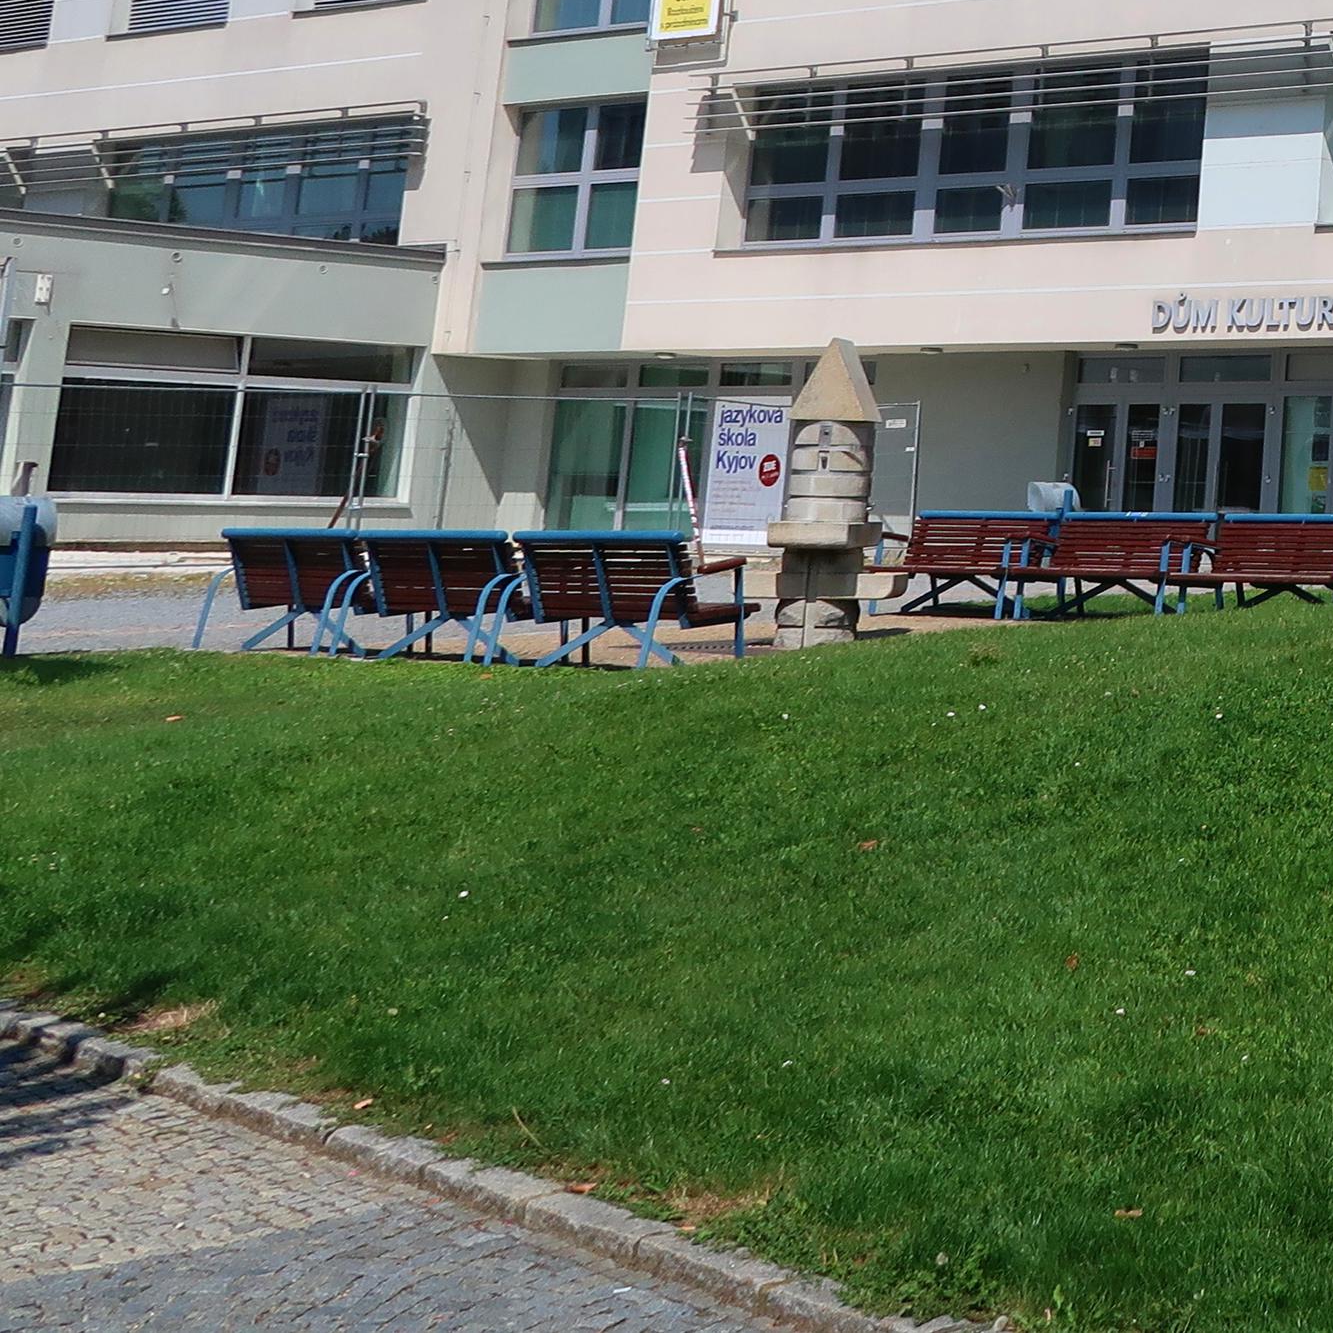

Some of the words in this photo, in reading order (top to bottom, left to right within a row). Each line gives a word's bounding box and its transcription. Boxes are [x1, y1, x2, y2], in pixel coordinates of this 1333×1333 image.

[1152, 292, 1219, 334] DŮM
[719, 404, 784, 427] jazyková
[718, 428, 757, 447] škola
[716, 450, 757, 473] Kyjov
